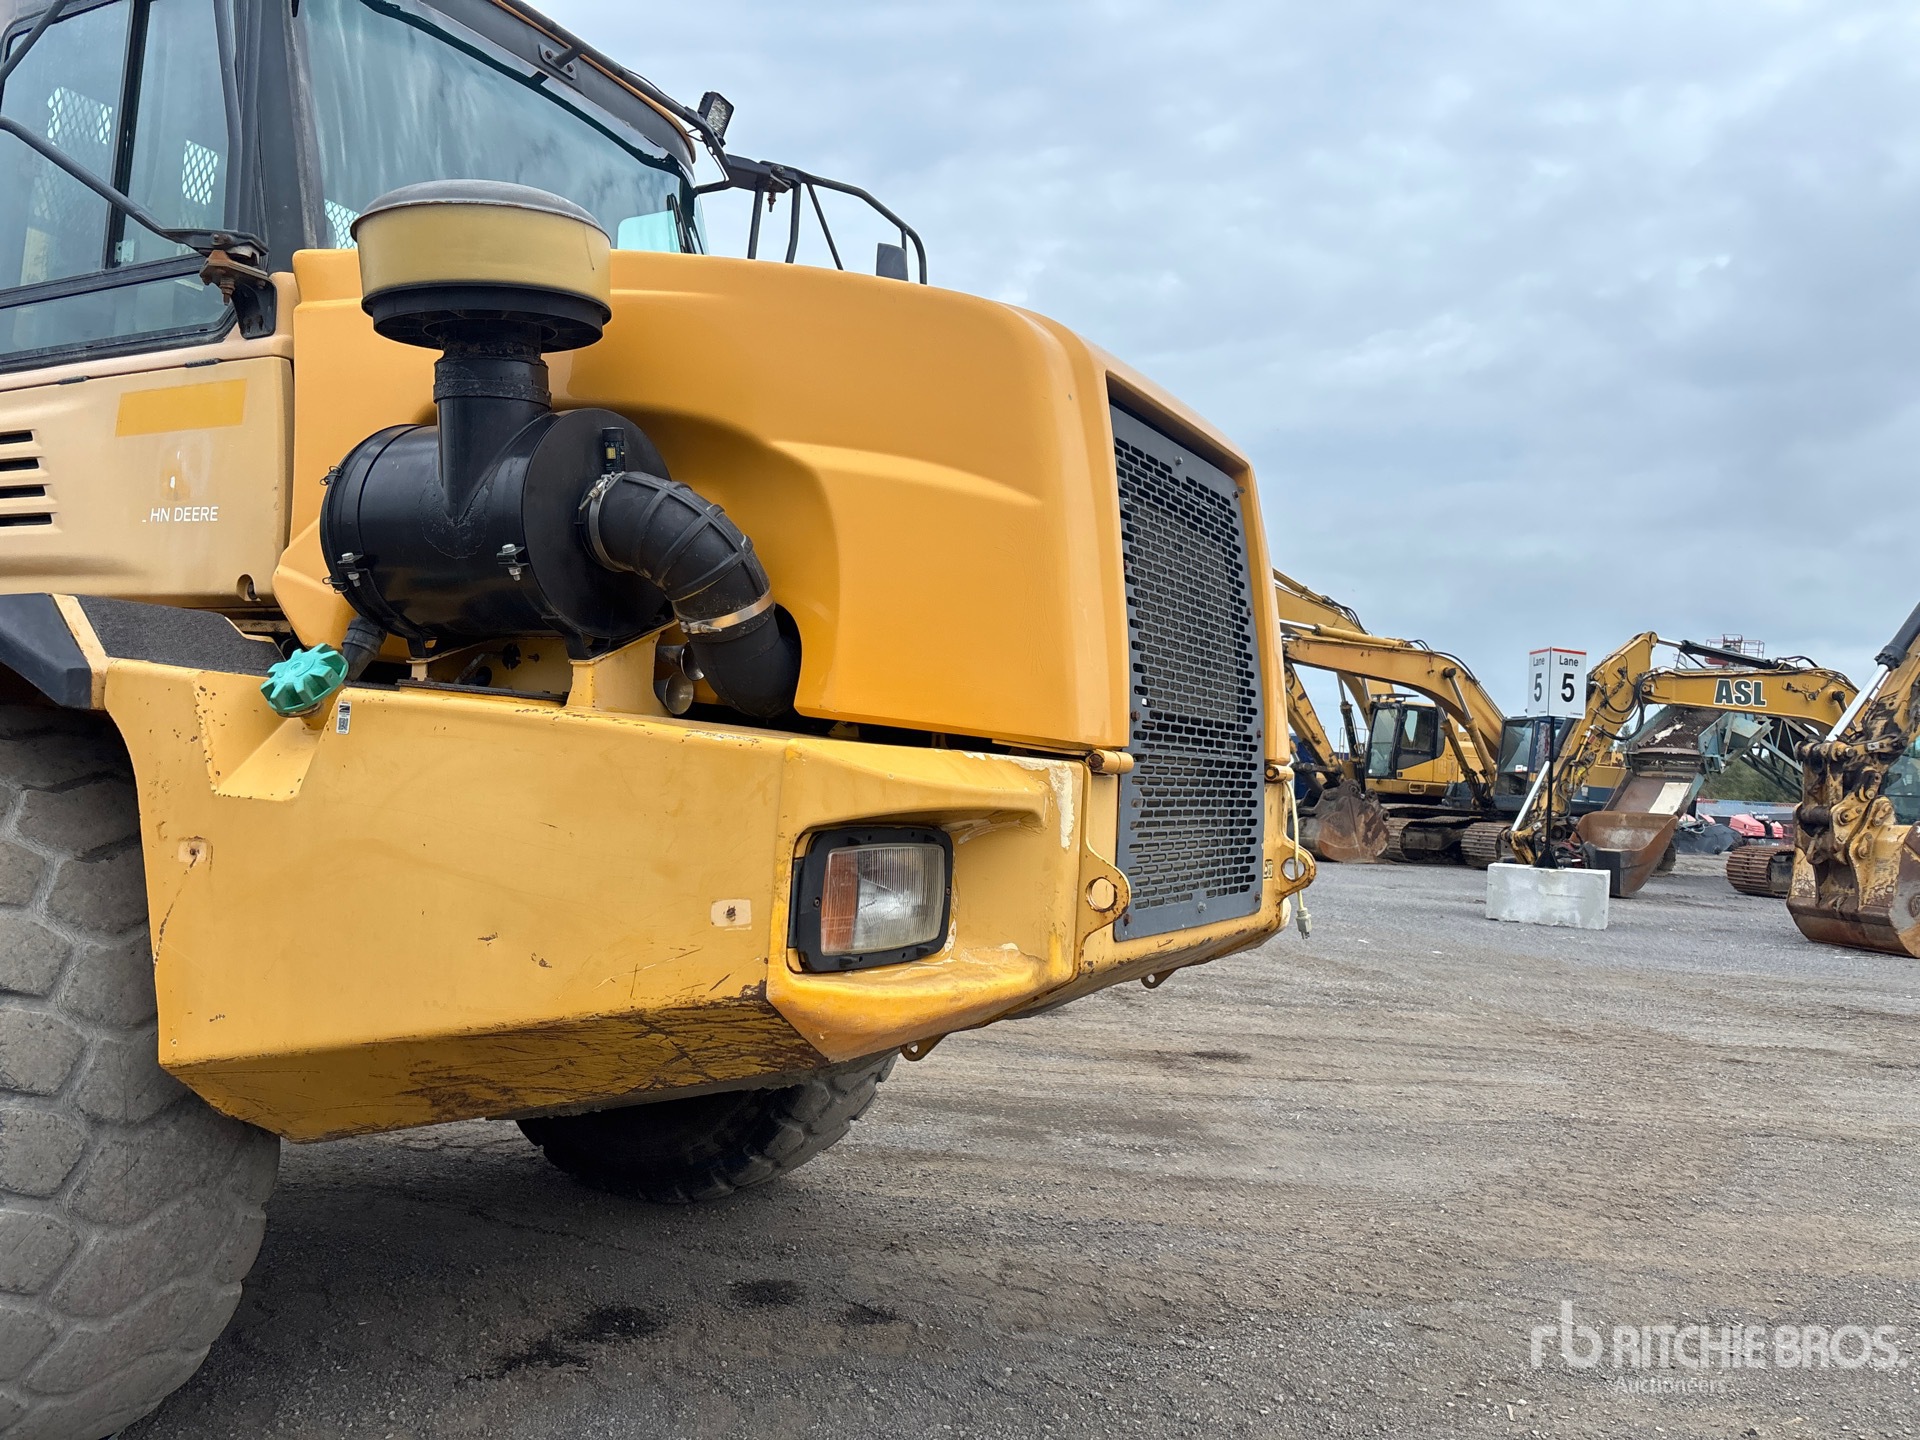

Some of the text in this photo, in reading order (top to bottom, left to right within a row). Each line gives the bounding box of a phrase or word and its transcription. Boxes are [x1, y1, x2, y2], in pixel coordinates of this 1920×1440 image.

[174, 506, 219, 522] DEERE
[1533, 657, 1545, 667] Lane
[1559, 655, 1579, 667] Lane
[1533, 672, 1543, 703] 5
[1561, 672, 1575, 703] 5
[1714, 679, 1767, 706] ASL
